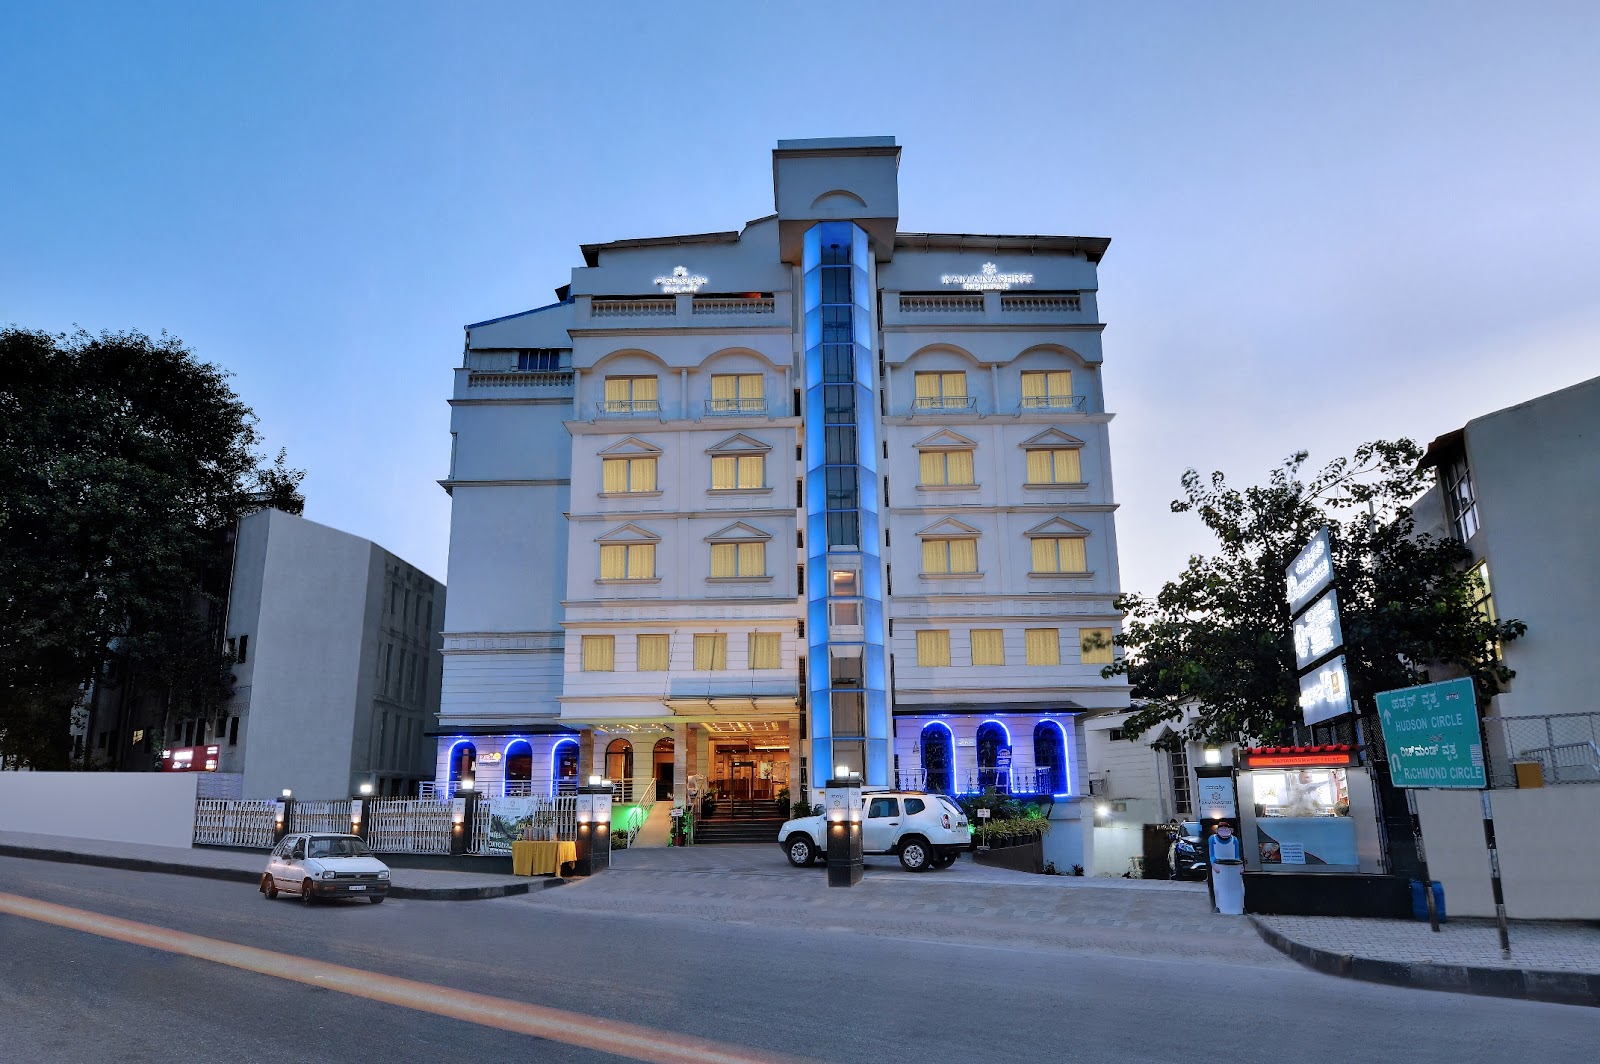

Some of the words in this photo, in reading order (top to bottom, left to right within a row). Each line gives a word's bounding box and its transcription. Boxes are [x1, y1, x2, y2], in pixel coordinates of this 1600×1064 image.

[942, 273, 1033, 284] RAMANASHREE
[1421, 691, 1440, 710] ವೃತ್ತ
[1395, 718, 1428, 732] HUDSON
[1431, 713, 1463, 728] CIRCLE
[1441, 742, 1458, 761] ವೃತ್ತ
[1450, 767, 1482, 779] CIRCLE
